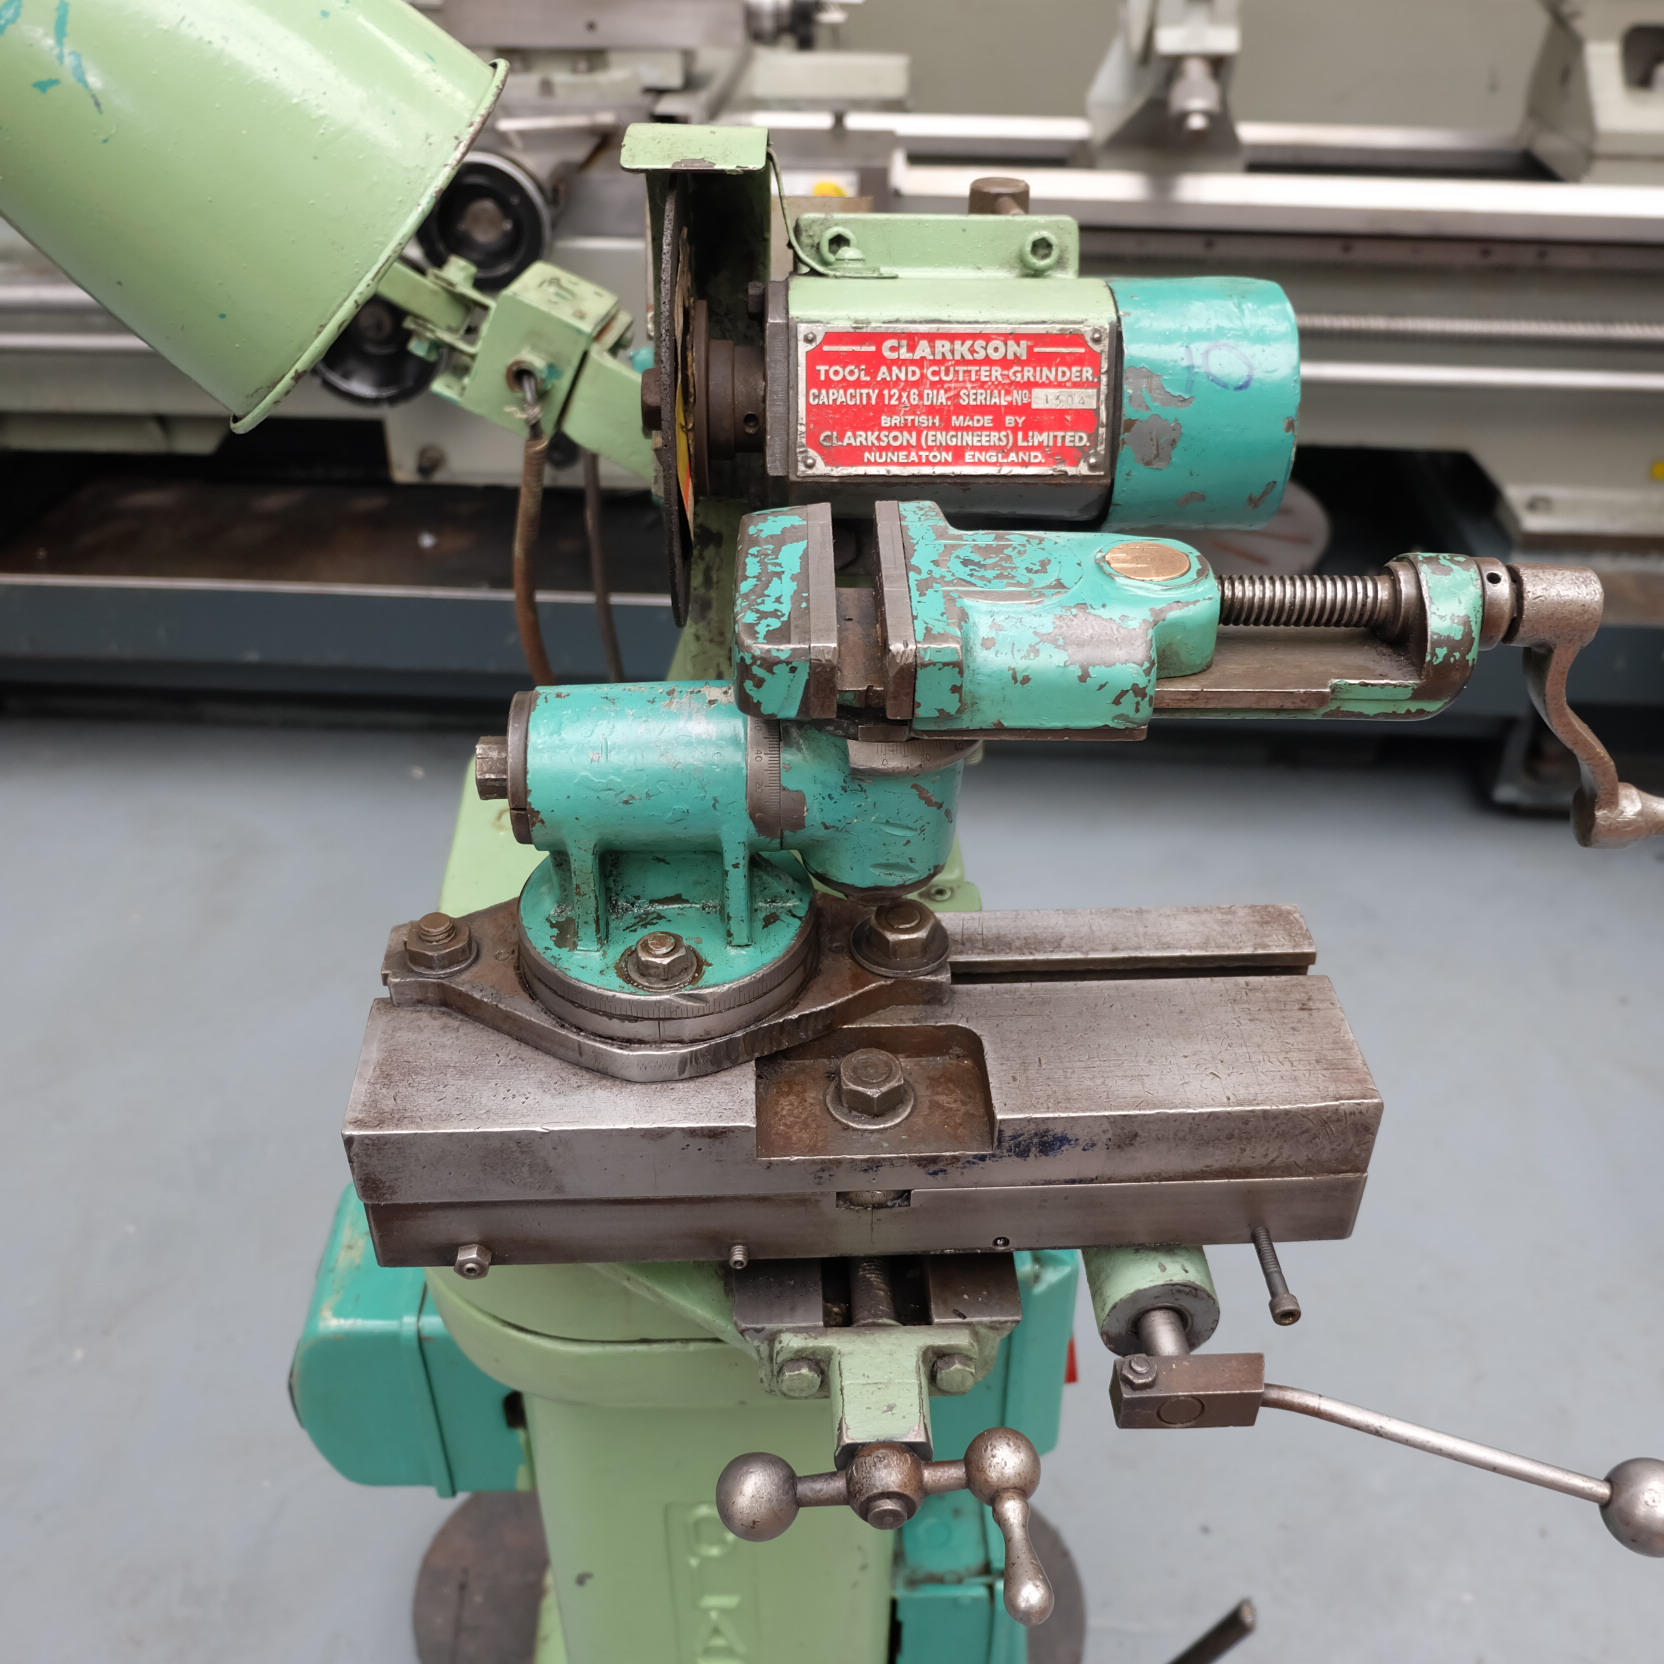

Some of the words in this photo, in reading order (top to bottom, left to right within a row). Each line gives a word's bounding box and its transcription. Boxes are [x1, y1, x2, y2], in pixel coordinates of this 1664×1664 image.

[881, 339, 1028, 360] CLARKSON
[815, 365, 871, 381] TOOL
[876, 365, 921, 382] AND
[808, 388, 879, 406] CAPACITY
[923, 389, 951, 406] DIA.
[880, 415, 940, 428] BRITISH
[951, 415, 993, 428] MADE
[1005, 415, 1026, 428] BY
[819, 431, 917, 447] CLARKSON
[920, 430, 1014, 449] (ENGINEERS)
[1017, 431, 1091, 447] LIMITED.
[863, 451, 953, 463] NUNEATON
[964, 451, 1046, 463] ENGLAND.
[754, 749, 763, 763] 40
